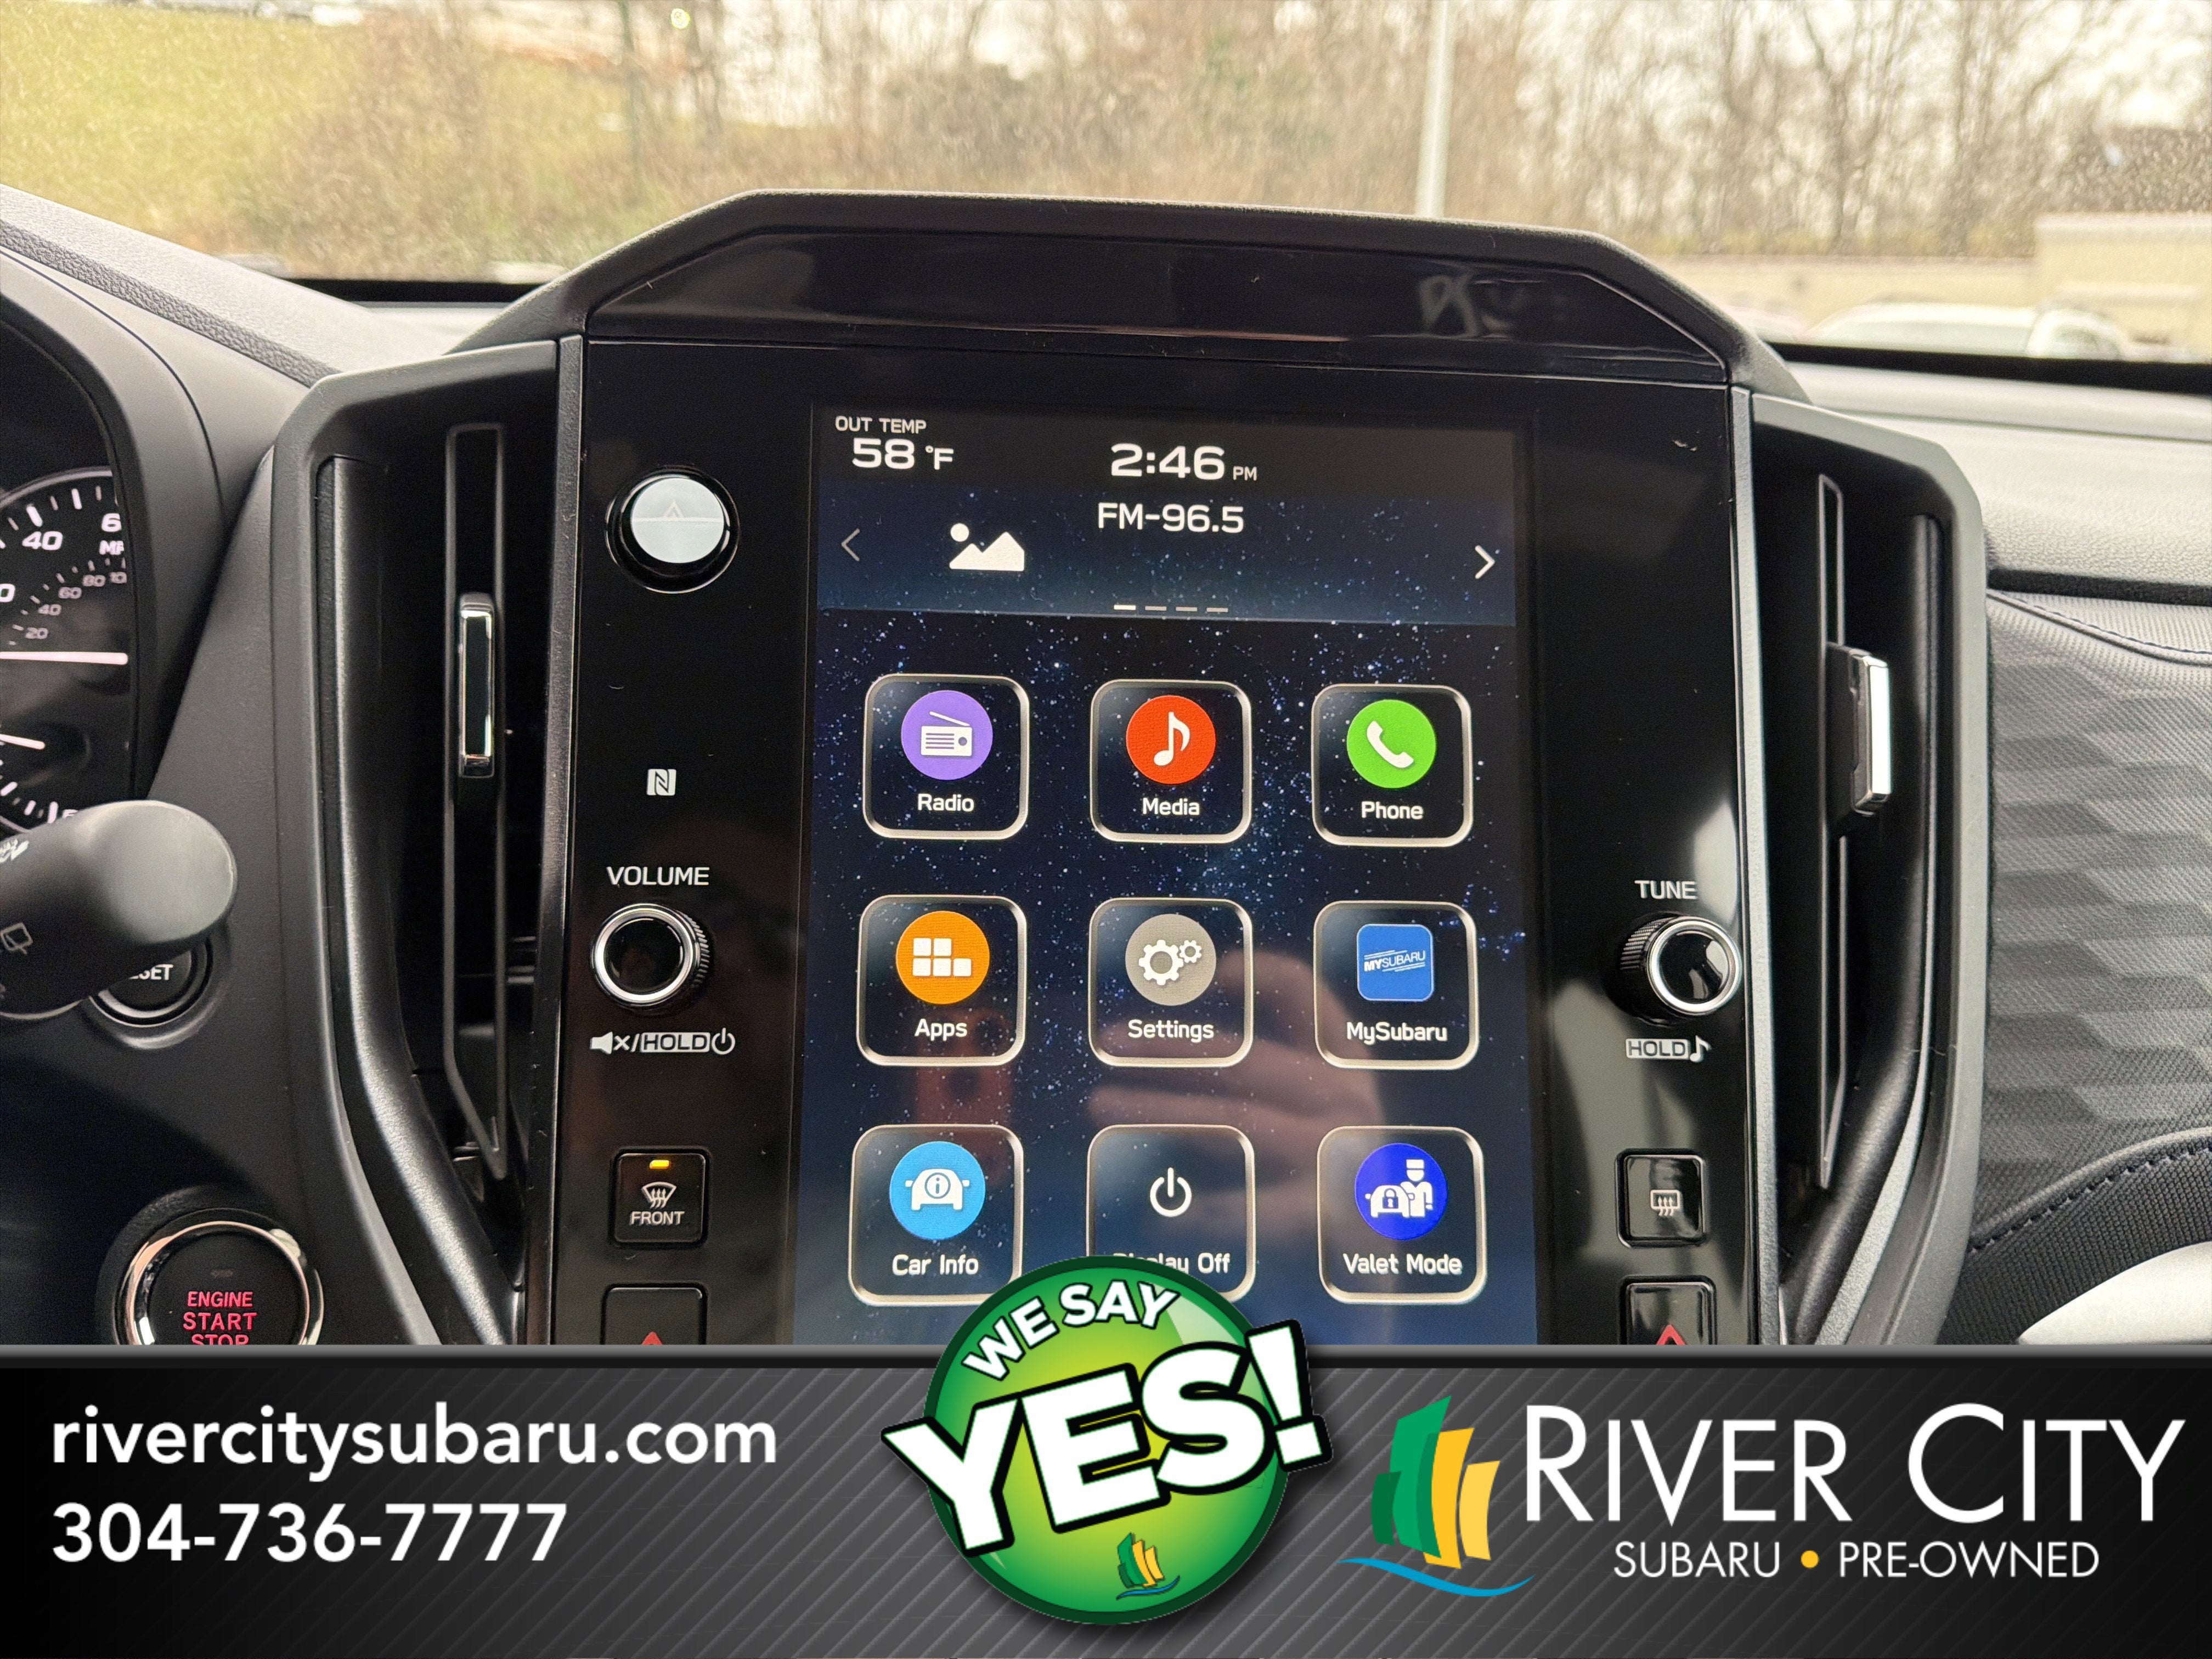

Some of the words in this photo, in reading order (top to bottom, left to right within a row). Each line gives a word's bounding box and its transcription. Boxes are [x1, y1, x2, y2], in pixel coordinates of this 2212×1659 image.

[835, 416, 873, 433] OUT
[878, 417, 927, 435] TEMP
[851, 438, 915, 470] 58
[1111, 443, 1226, 481] 2:46
[1232, 465, 1258, 482] PM
[1097, 501, 1244, 534] FM-96.5
[22, 531, 63, 550] 40
[37, 603, 62, 616] 40
[24, 627, 49, 640] 20
[917, 793, 974, 812] Radio
[1142, 797, 1200, 816] Media
[1361, 800, 1424, 820] Phone
[606, 866, 710, 886] VOLUME
[1634, 880, 1697, 900] TUNE
[1364, 950, 1426, 972] MYSUBARU
[914, 1018, 968, 1041] Apps
[1127, 1019, 1215, 1043] Settings
[1346, 1022, 1448, 1046] MySubaru
[1627, 1040, 1688, 1058] HOLD
[629, 1211, 685, 1226] FRONT
[891, 1254, 932, 1277] Car
[939, 1254, 979, 1276] Info
[1197, 1251, 1231, 1274] Off
[1342, 1253, 1400, 1276] Valet
[1406, 1253, 1464, 1276] Mode
[187, 1291, 254, 1308] ENGINE
[182, 1312, 258, 1331] START
